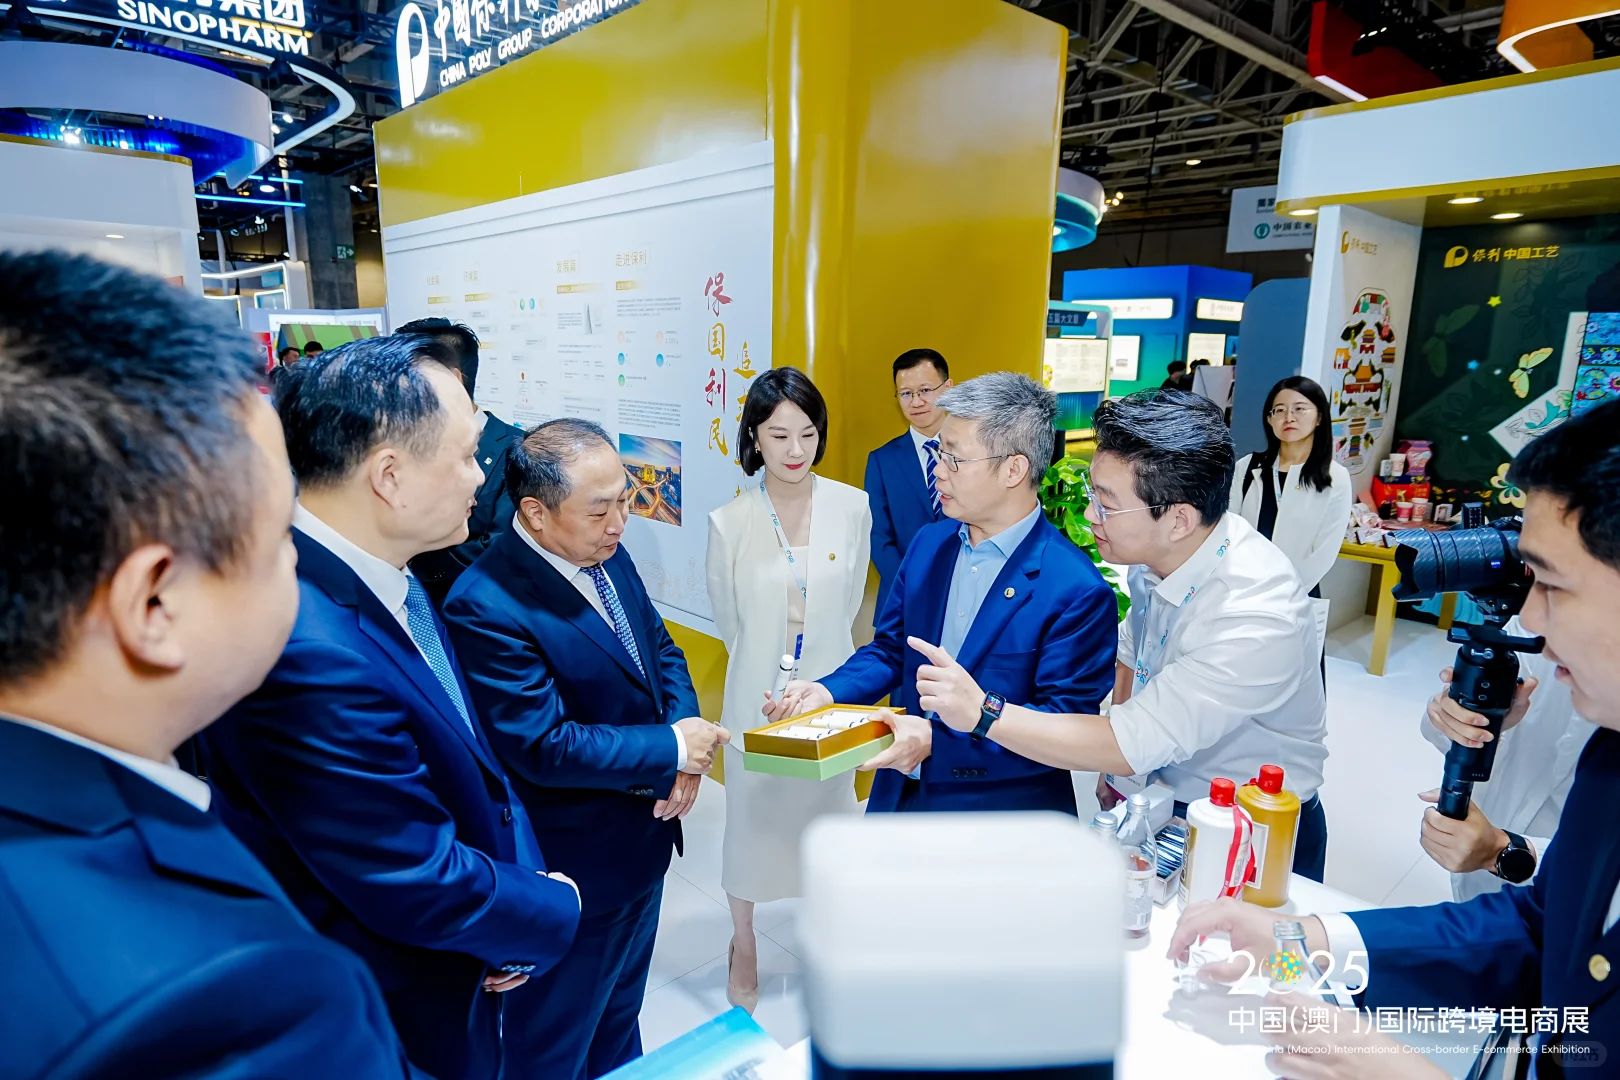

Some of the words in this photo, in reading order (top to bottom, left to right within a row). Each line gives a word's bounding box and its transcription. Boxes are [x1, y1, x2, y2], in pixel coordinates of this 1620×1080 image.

[117, 0, 309, 56] SINOPHARM
[439, 61, 467, 88] CHINA
[468, 47, 492, 74] POLY
[497, 27, 532, 59] GROUP
[615, 249, 647, 267] 走进保利
